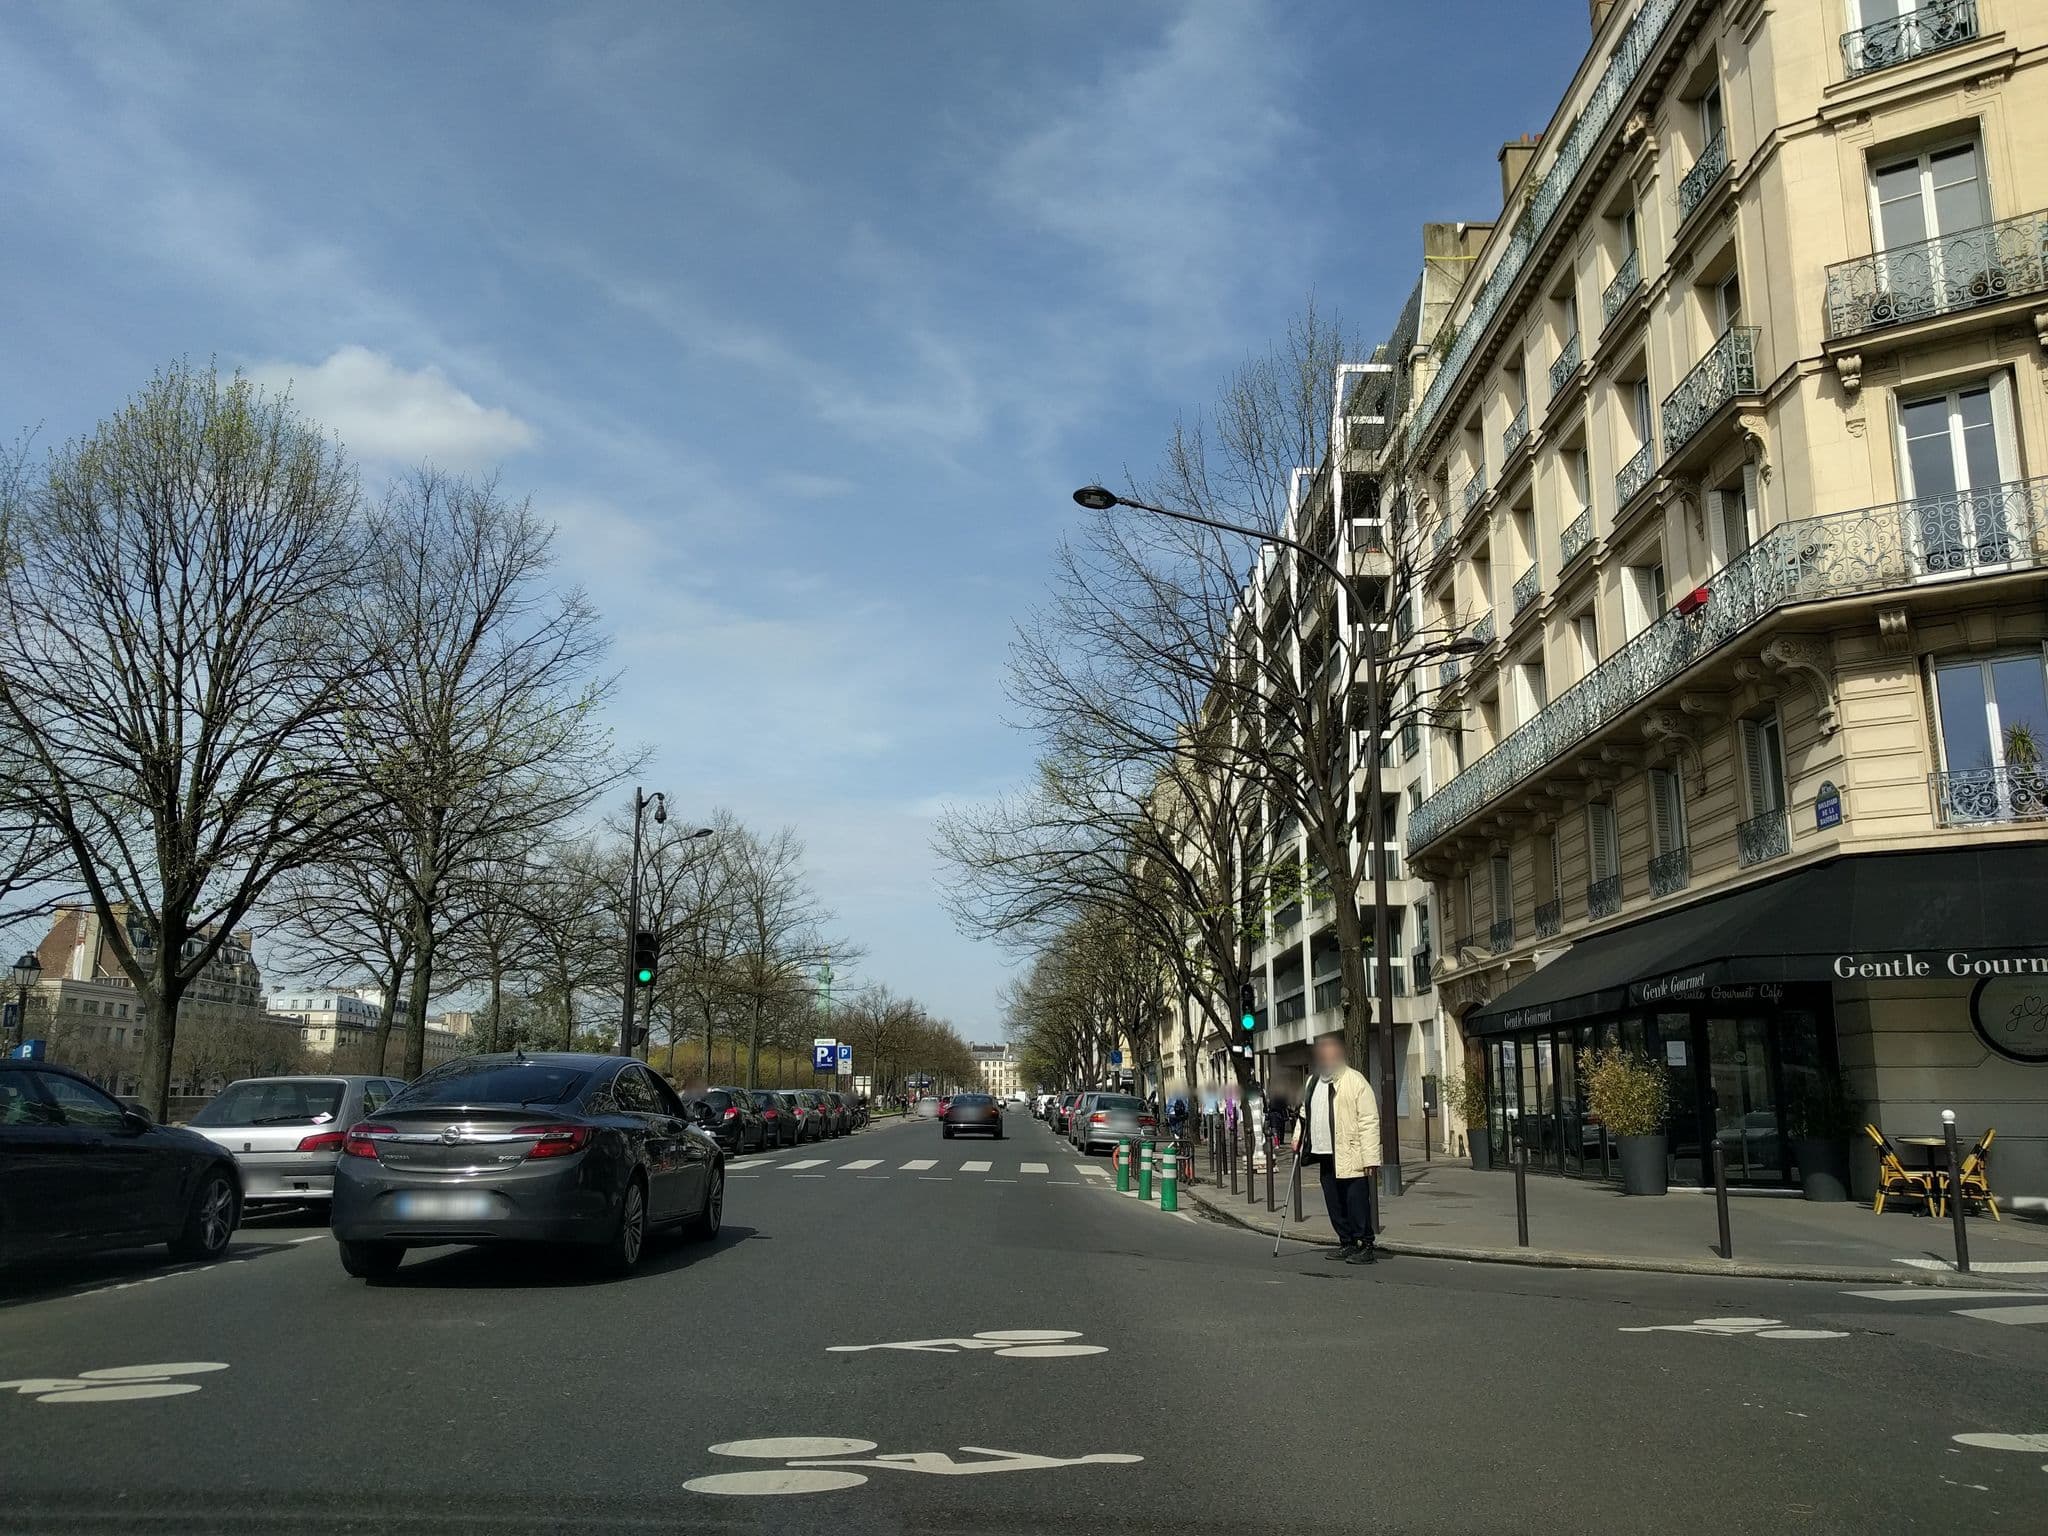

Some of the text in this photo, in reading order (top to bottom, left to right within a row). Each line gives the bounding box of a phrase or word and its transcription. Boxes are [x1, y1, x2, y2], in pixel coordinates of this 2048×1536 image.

[1833, 954, 1930, 979] Gentle
[1642, 972, 1705, 1001] Gentle Gourmet
[1711, 985, 1754, 999] Gourmet
[1524, 1008, 1551, 1025] Gourmet
[816, 1047, 829, 1062] P
[841, 1048, 848, 1058] P
